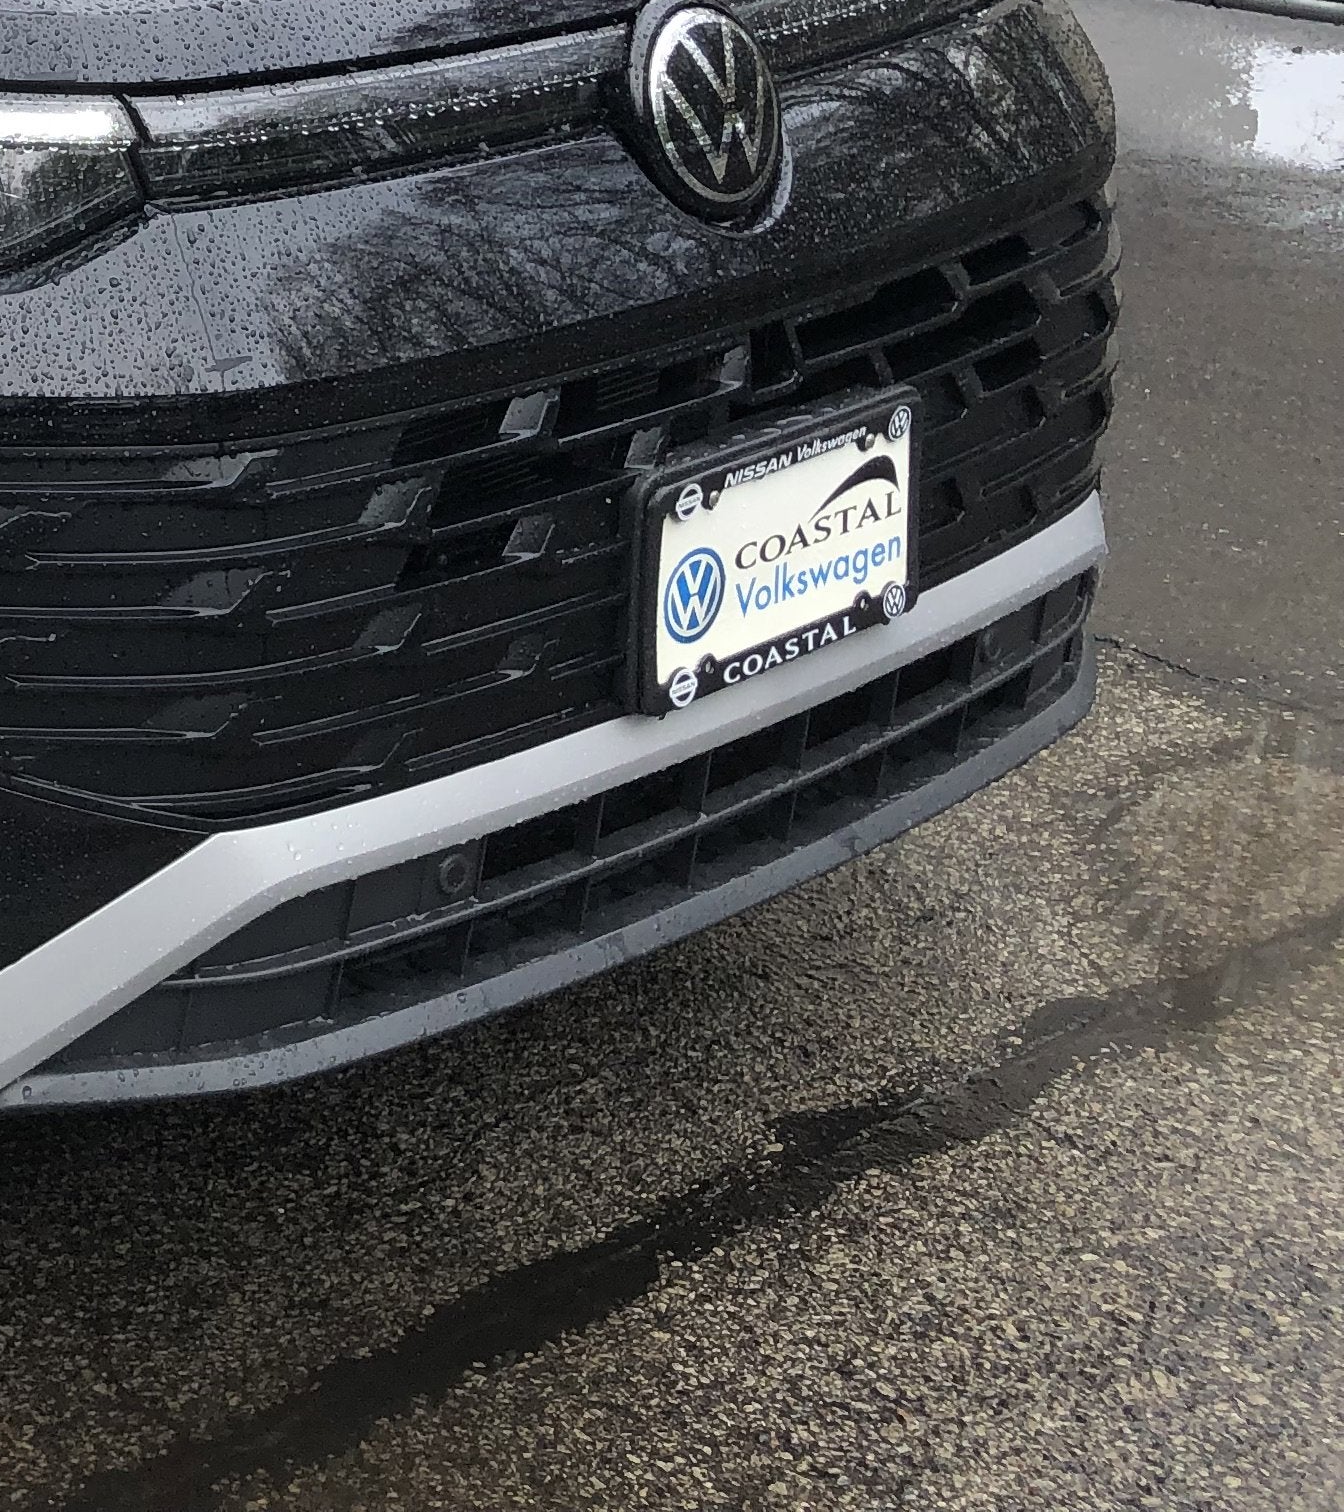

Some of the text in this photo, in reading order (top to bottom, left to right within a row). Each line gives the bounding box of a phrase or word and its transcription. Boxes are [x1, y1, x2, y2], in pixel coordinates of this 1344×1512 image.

[724, 425, 867, 488] NISSAN Volkswagen
[735, 492, 902, 570] COASTAL
[735, 535, 901, 618] Volkswagen
[723, 616, 857, 684] COASTAL
